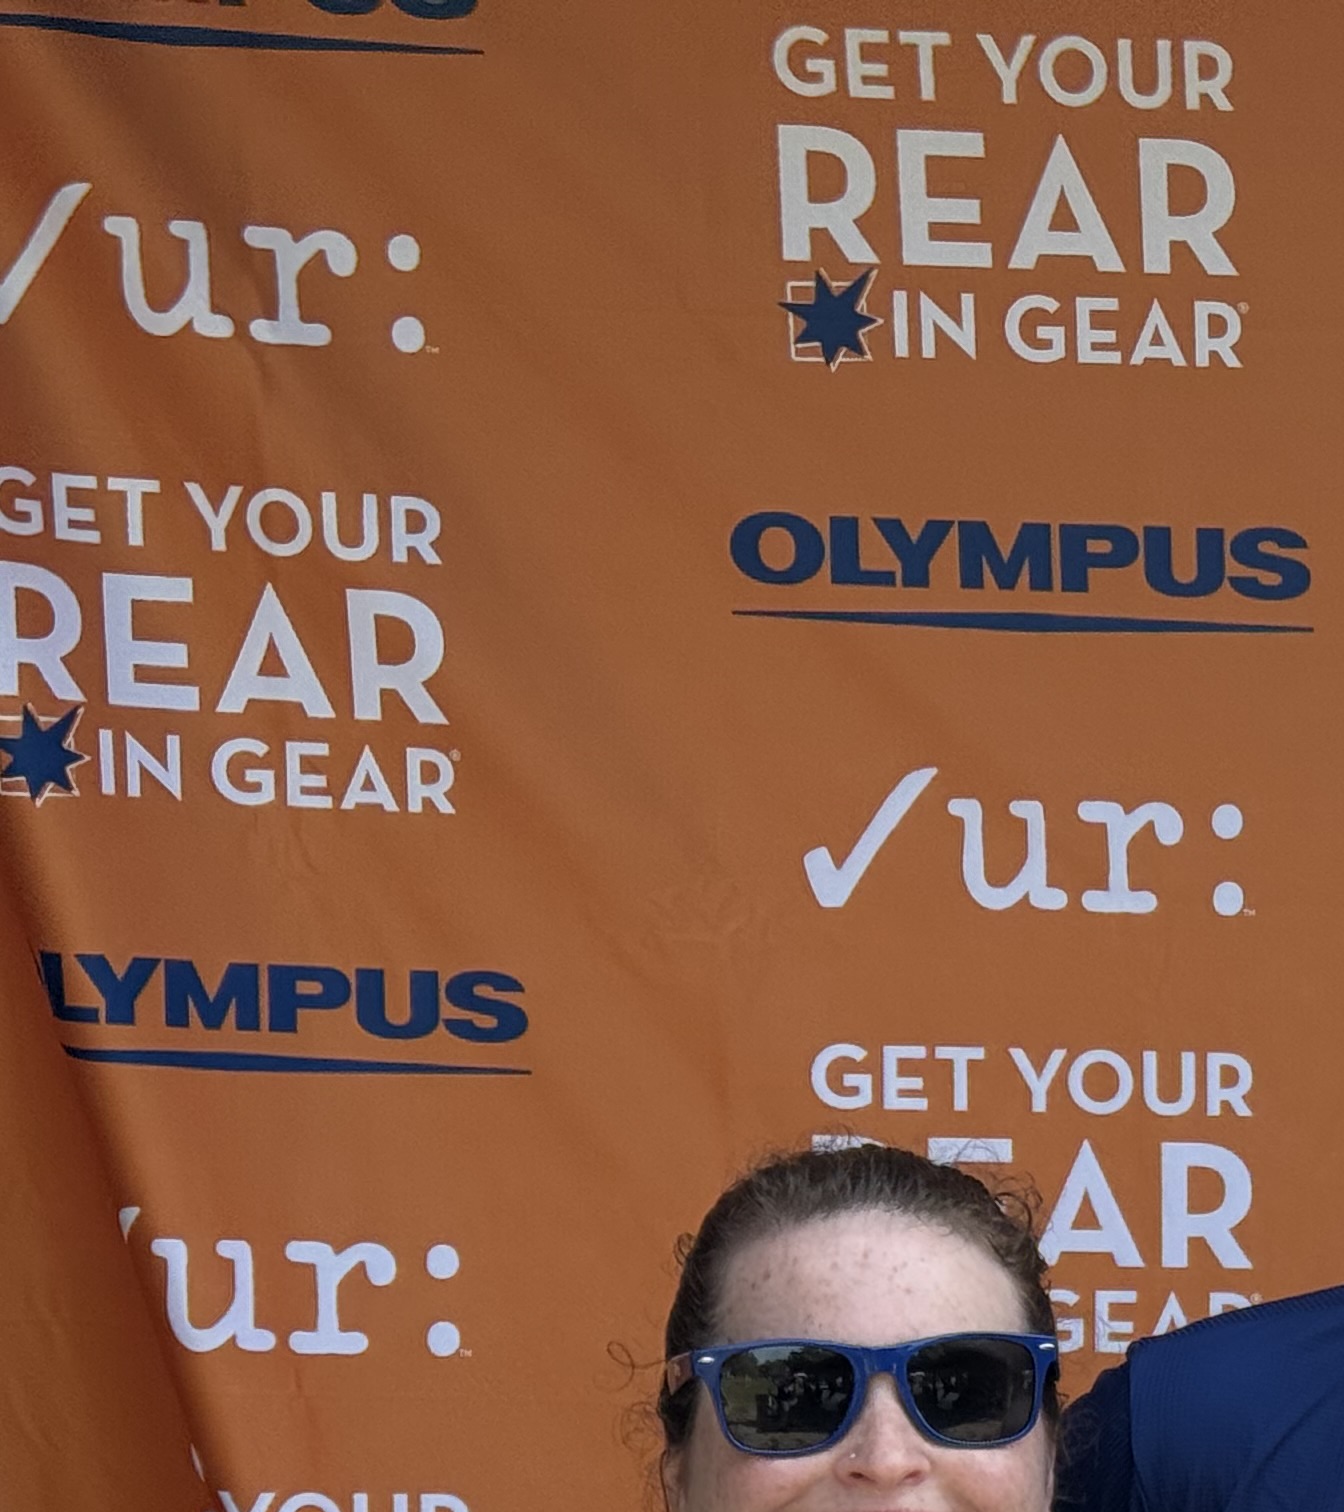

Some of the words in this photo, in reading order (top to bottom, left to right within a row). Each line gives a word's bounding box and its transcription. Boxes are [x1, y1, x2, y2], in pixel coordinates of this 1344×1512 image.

[773, 26, 950, 102] GET
[977, 34, 1234, 112] YOUR
[777, 123, 1239, 277] REAR
[892, 290, 977, 361] IN
[1005, 295, 1244, 369] GEAR
[0, 467, 160, 547] GET
[184, 482, 443, 566] YOUR
[729, 512, 1311, 602] OLYMPUS
[0, 561, 449, 724] REAR
[100, 729, 182, 801] IN
[211, 739, 456, 814] GEAR
[39, 950, 529, 1043] LYMPUS
[811, 1044, 985, 1111] GET
[1007, 1048, 1253, 1117] YOUR
[812, 1134, 1253, 1270] AR
[1048, 1289, 1252, 1353] GEA
